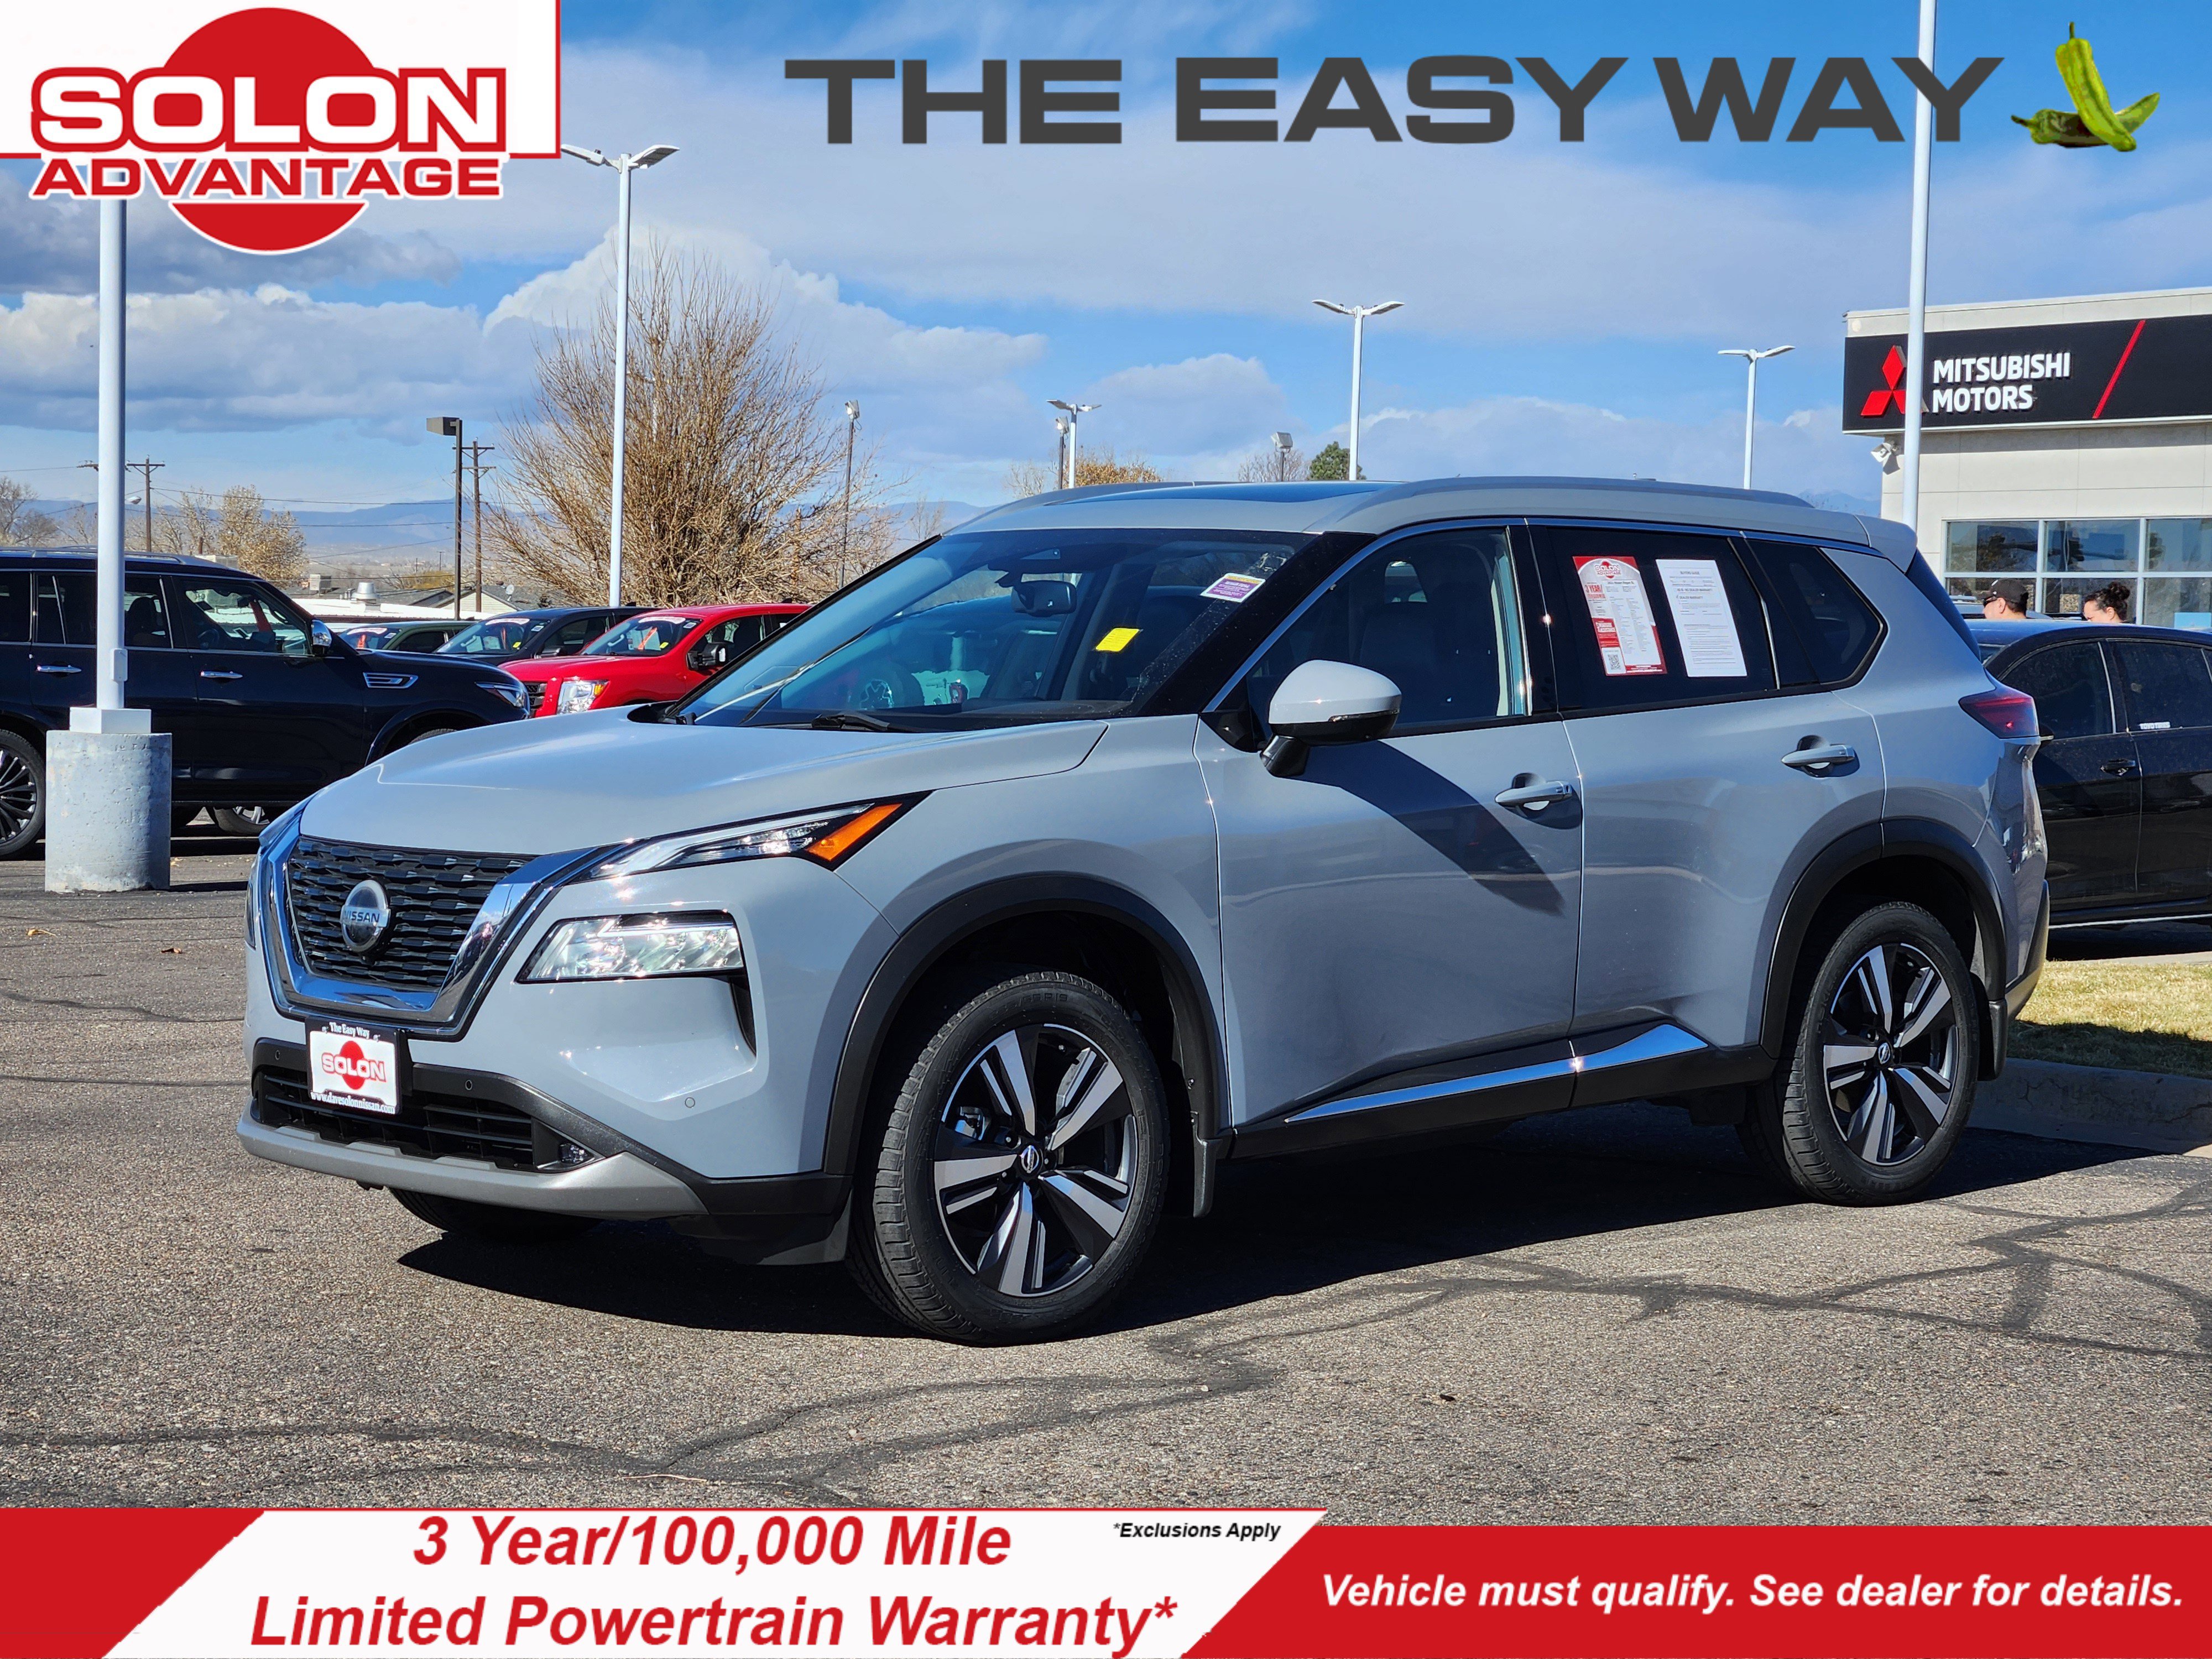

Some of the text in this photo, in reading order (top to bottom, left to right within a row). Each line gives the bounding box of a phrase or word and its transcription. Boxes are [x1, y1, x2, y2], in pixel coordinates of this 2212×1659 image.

[1933, 352, 2070, 384] MITSUBISHI
[1932, 384, 2034, 414] MOTORS
[344, 910, 380, 923] NISSAN
[329, 1021, 370, 1040] The Easy Way
[321, 1052, 387, 1082] SOLON
[310, 1092, 395, 1114] www.davesolonnissan.com
